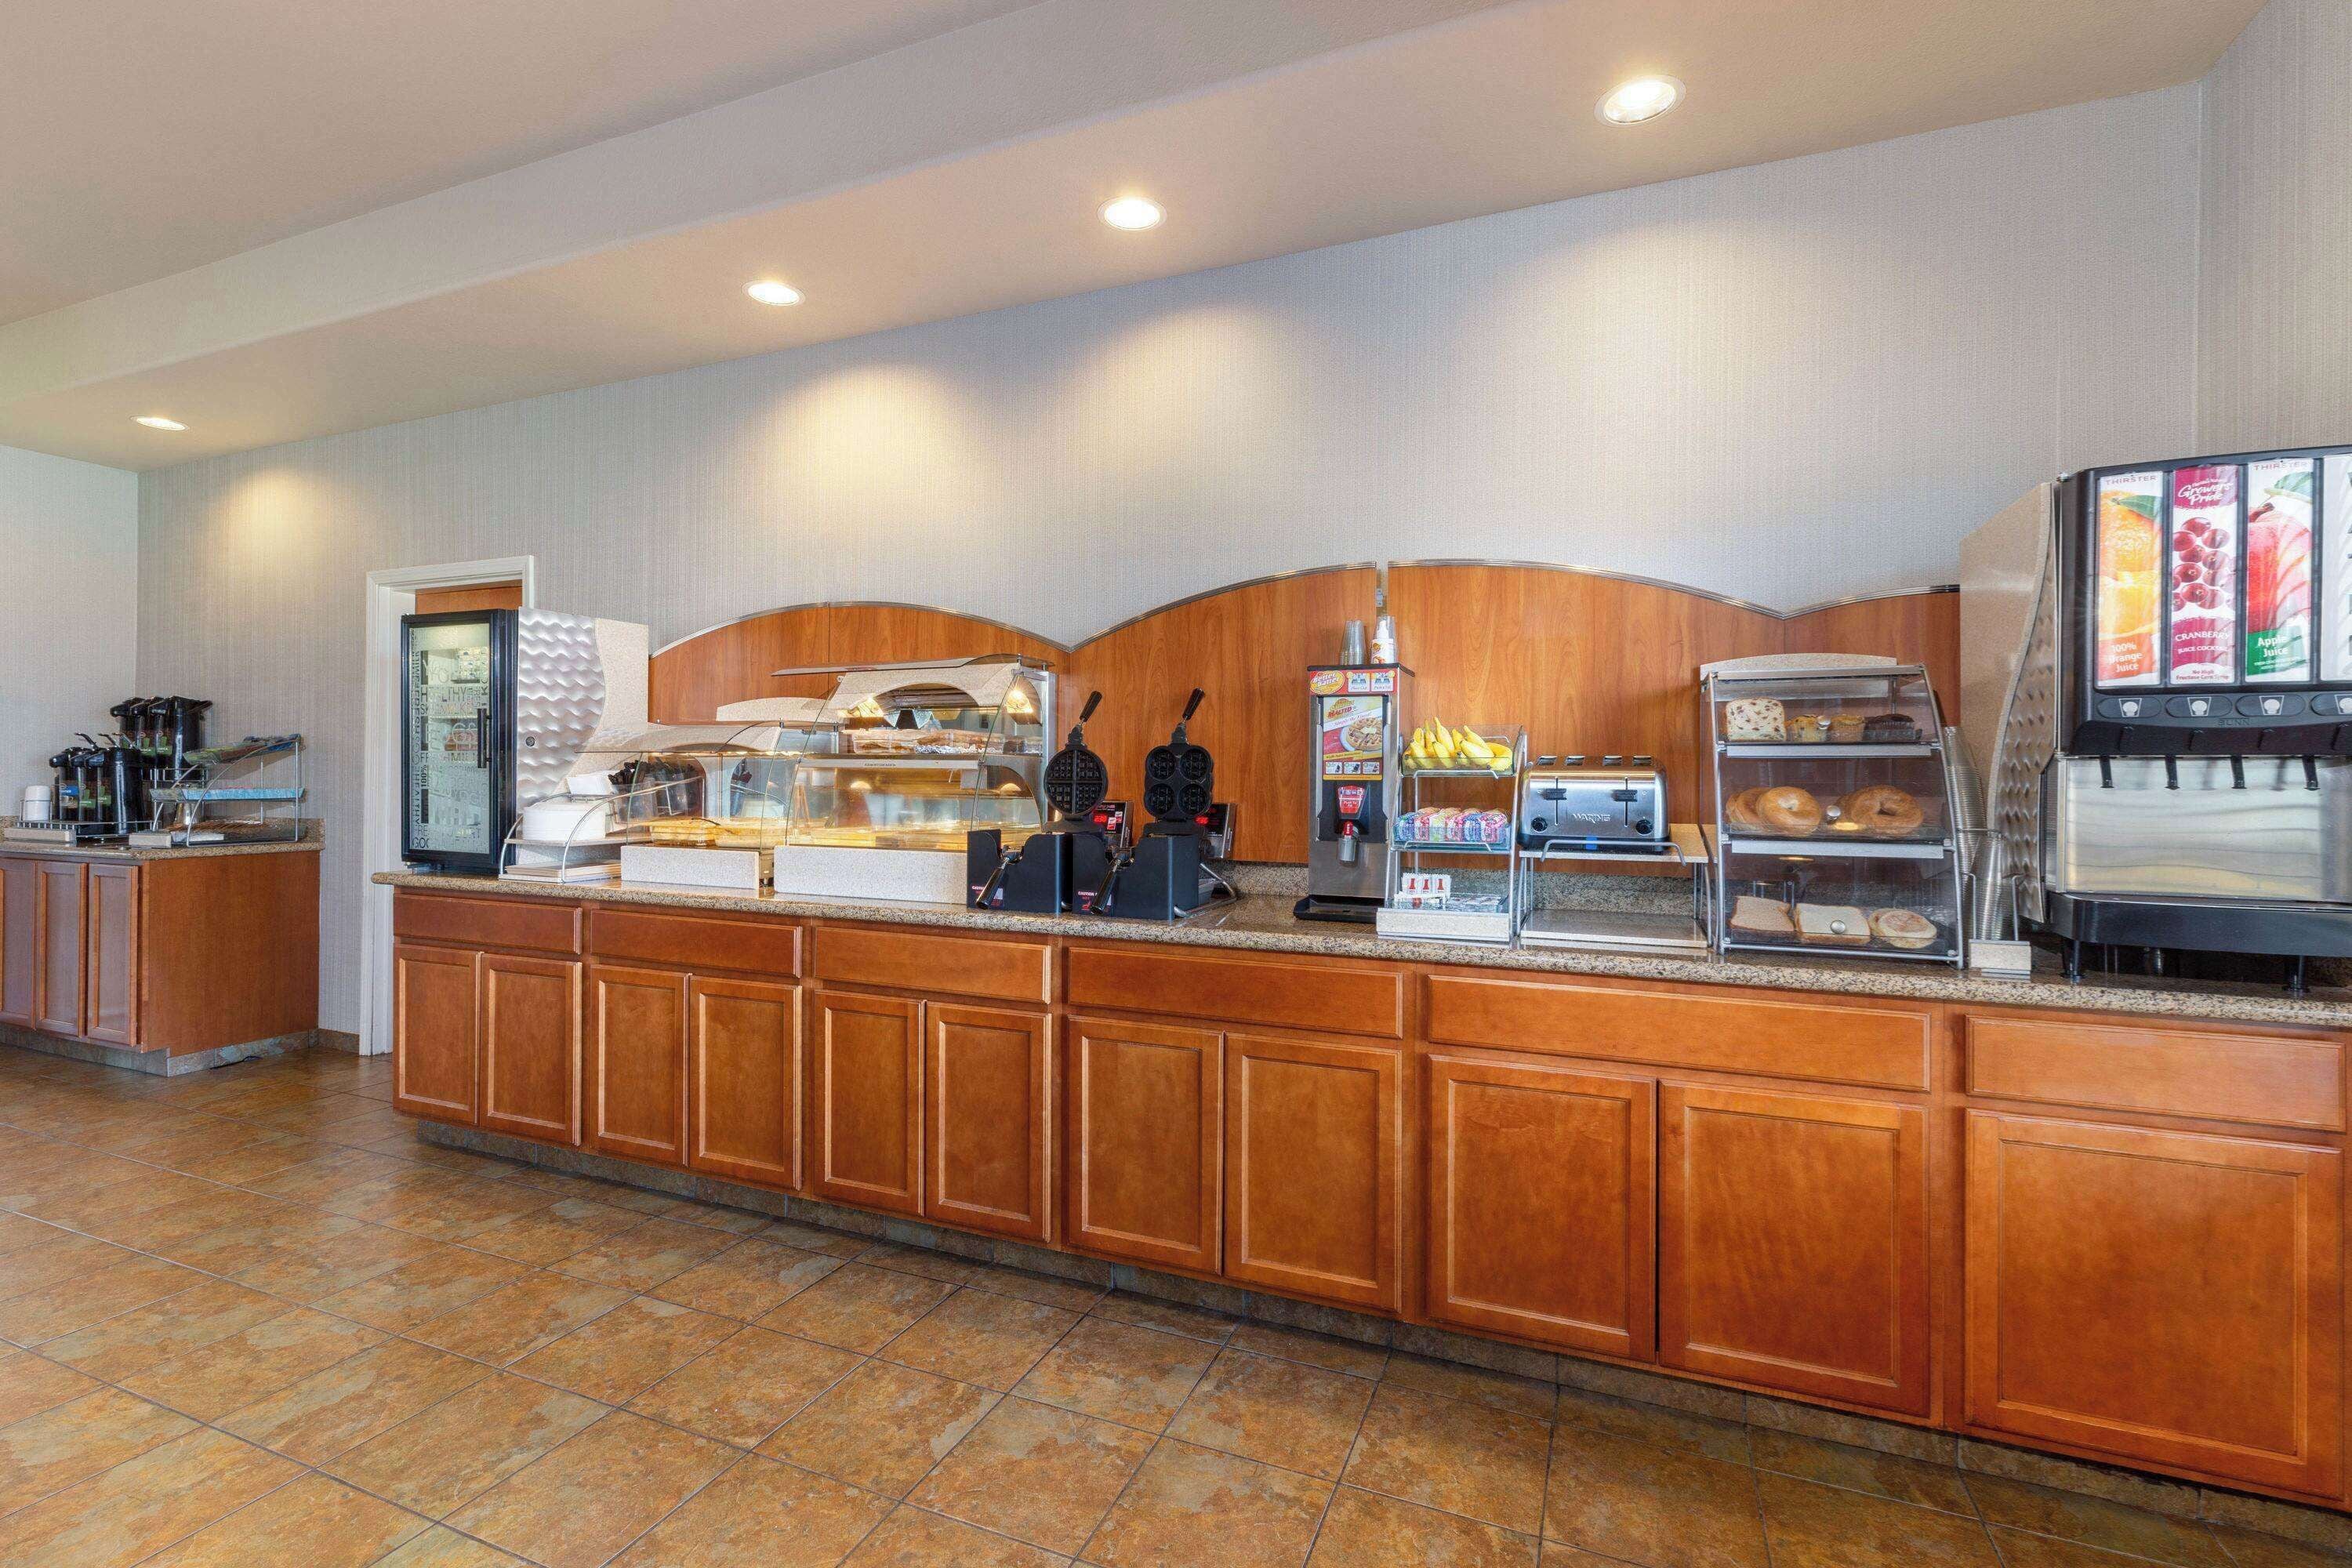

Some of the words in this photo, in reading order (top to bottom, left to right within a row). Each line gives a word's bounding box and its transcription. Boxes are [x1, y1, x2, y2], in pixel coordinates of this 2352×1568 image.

[2189, 492, 2223, 506] Pride
[2175, 630, 2230, 641] CRANBERRY
[2111, 641, 2136, 652] 100%
[2257, 636, 2288, 648] Apple
[2178, 646, 2196, 655] JUICE
[2263, 648, 2288, 658] Juice
[2108, 652, 2143, 663] Orange
[2116, 663, 2139, 673] Juice
